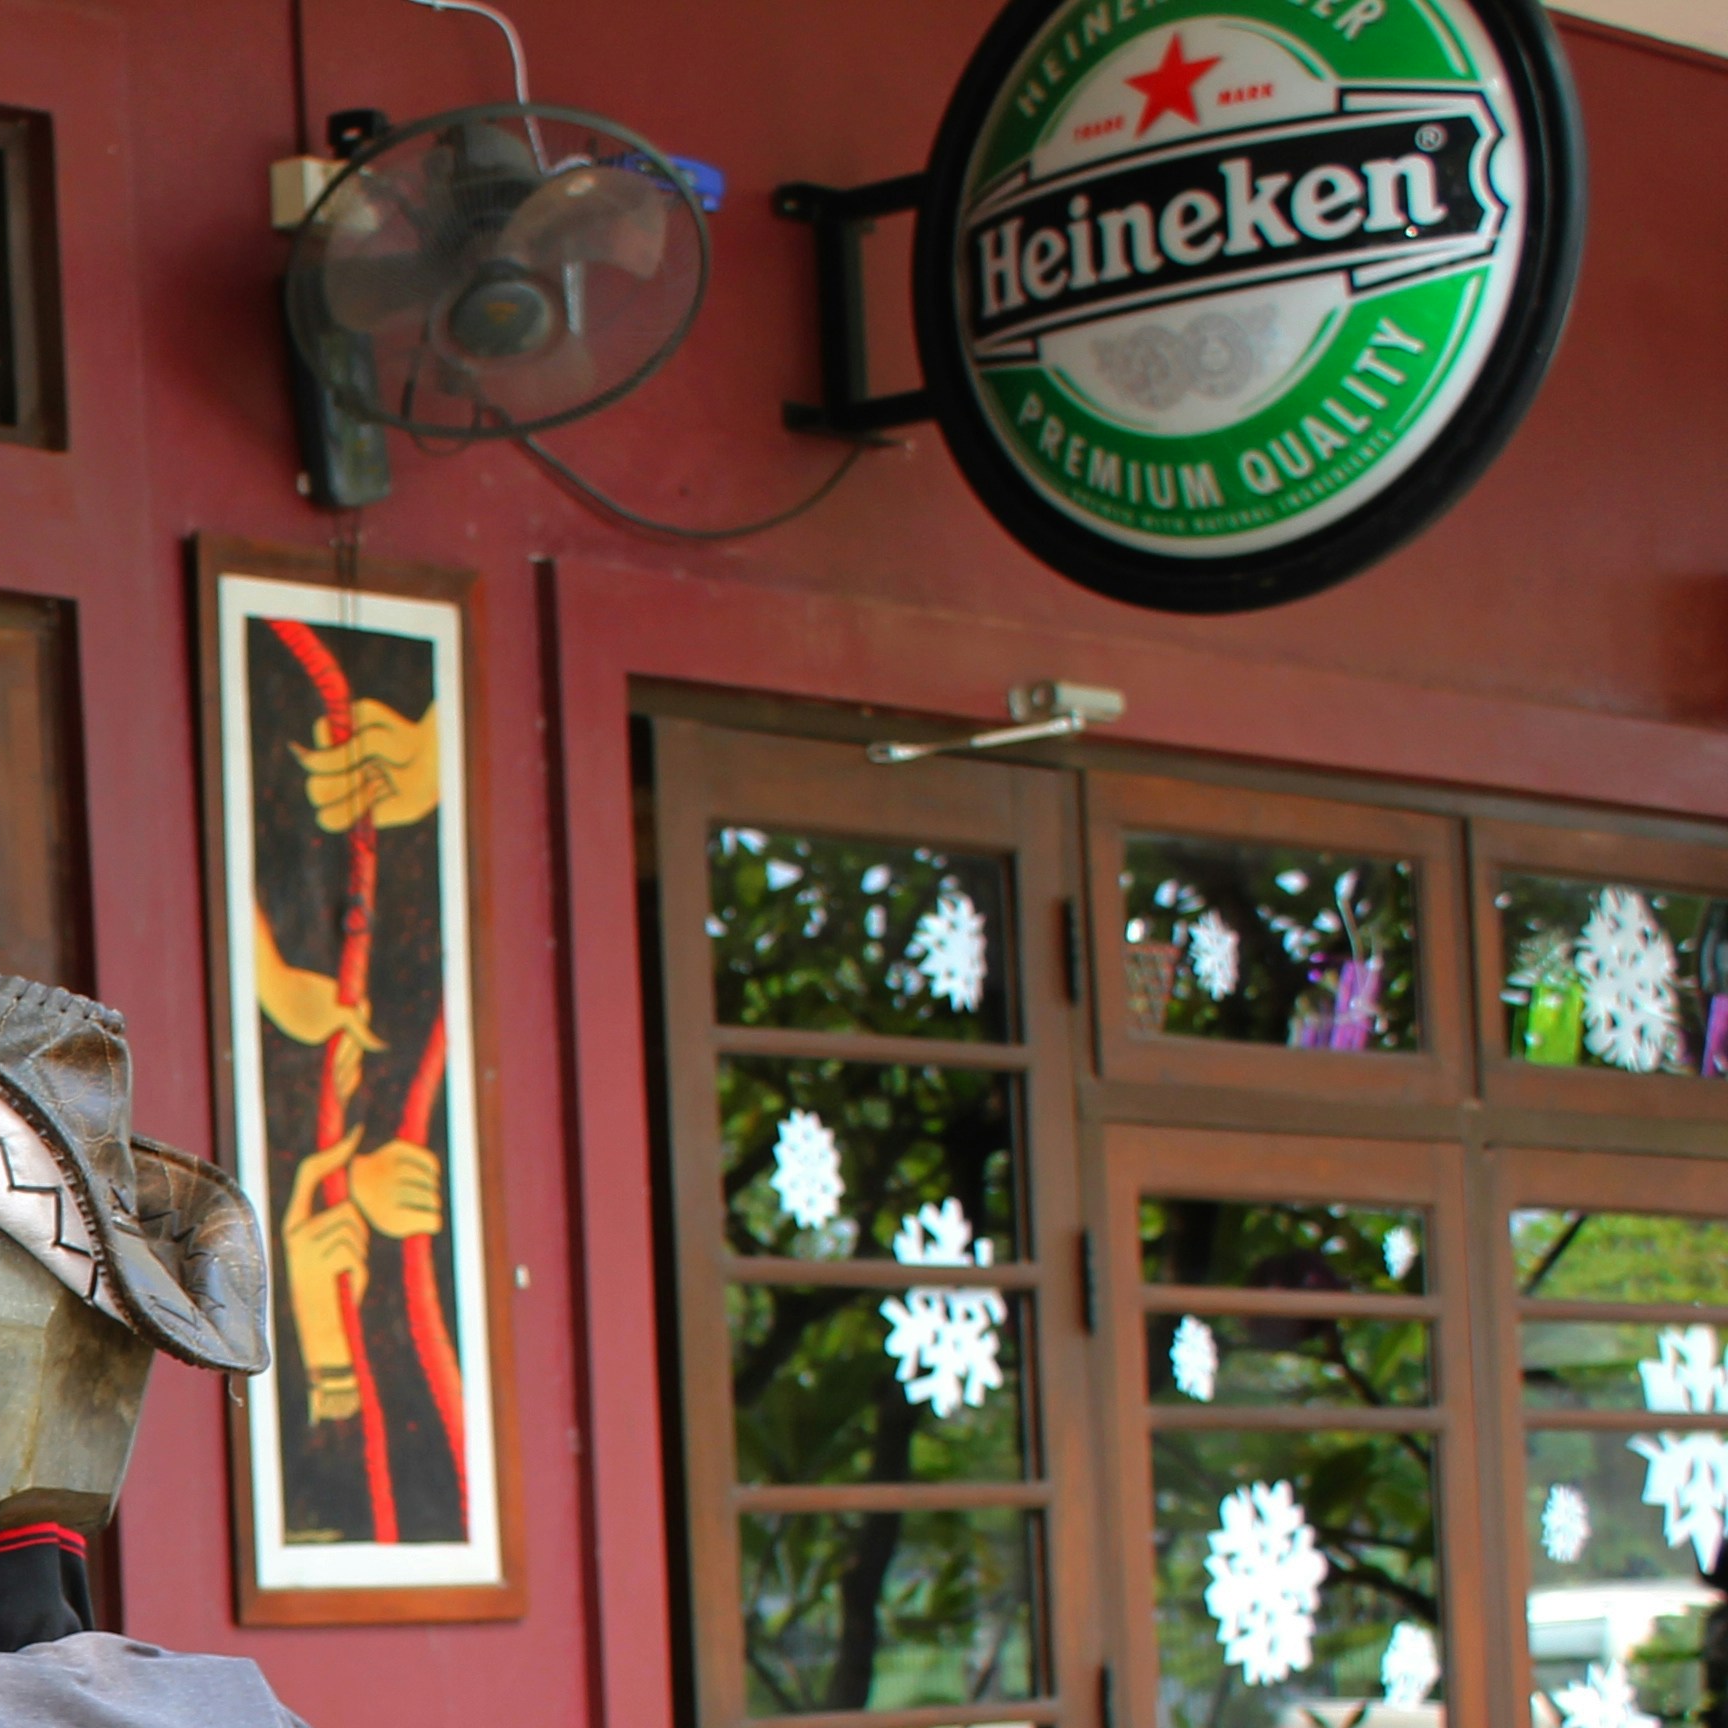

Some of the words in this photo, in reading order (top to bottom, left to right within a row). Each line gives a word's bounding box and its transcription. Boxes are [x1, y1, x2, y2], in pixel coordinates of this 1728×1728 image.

[1017, 0, 1164, 117] HEINE
[1073, 113, 1126, 142] TRADE
[1217, 83, 1275, 107] MARK
[980, 153, 1446, 319] Heineken
[1018, 395, 1224, 509] PREMIUM
[1239, 319, 1426, 494] QUALITY
